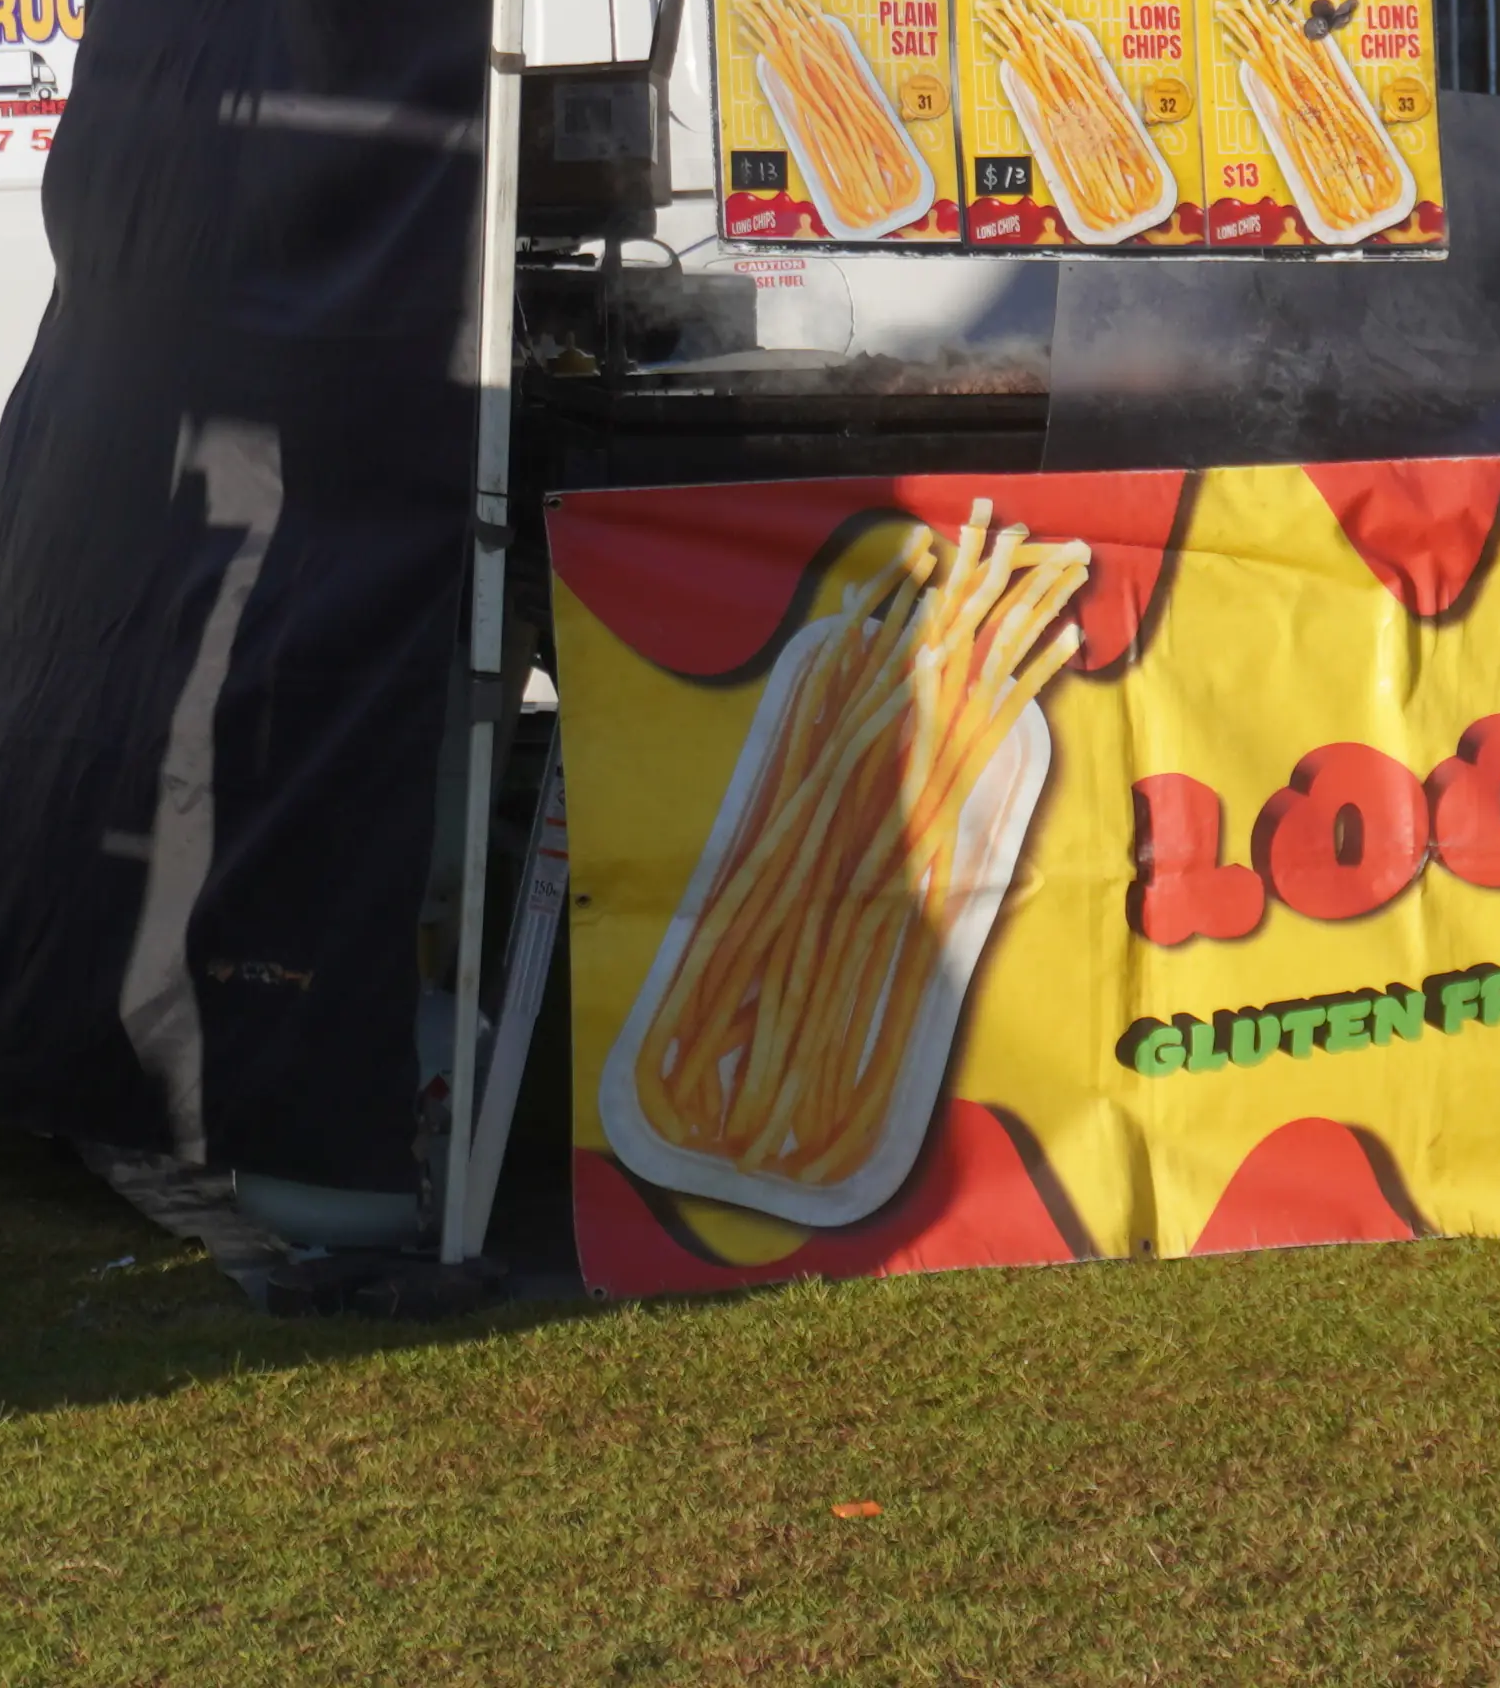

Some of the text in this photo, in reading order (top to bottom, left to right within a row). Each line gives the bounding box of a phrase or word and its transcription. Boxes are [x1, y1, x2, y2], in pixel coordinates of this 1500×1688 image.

[880, 1, 938, 27] PLAIN
[1128, 5, 1180, 30] LONG
[1366, 5, 1418, 30] LONG
[891, 31, 938, 56] SALT
[1122, 34, 1182, 60] CHIPS
[1361, 34, 1420, 60] CHIPS
[918, 94, 932, 111] 31
[1160, 98, 1177, 113] 32
[1398, 96, 1415, 113] 33
[1004, 165, 1027, 188] 13
[1223, 163, 1259, 188] $13
[731, 211, 776, 235] LONG CHIPS
[976, 214, 1021, 240] LONG CHIPS
[1216, 214, 1261, 240] LONG CHIPS
[736, 260, 802, 272] CAUTION
[779, 276, 804, 287] FUEL
[1116, 988, 1428, 1079] GLUTEN
